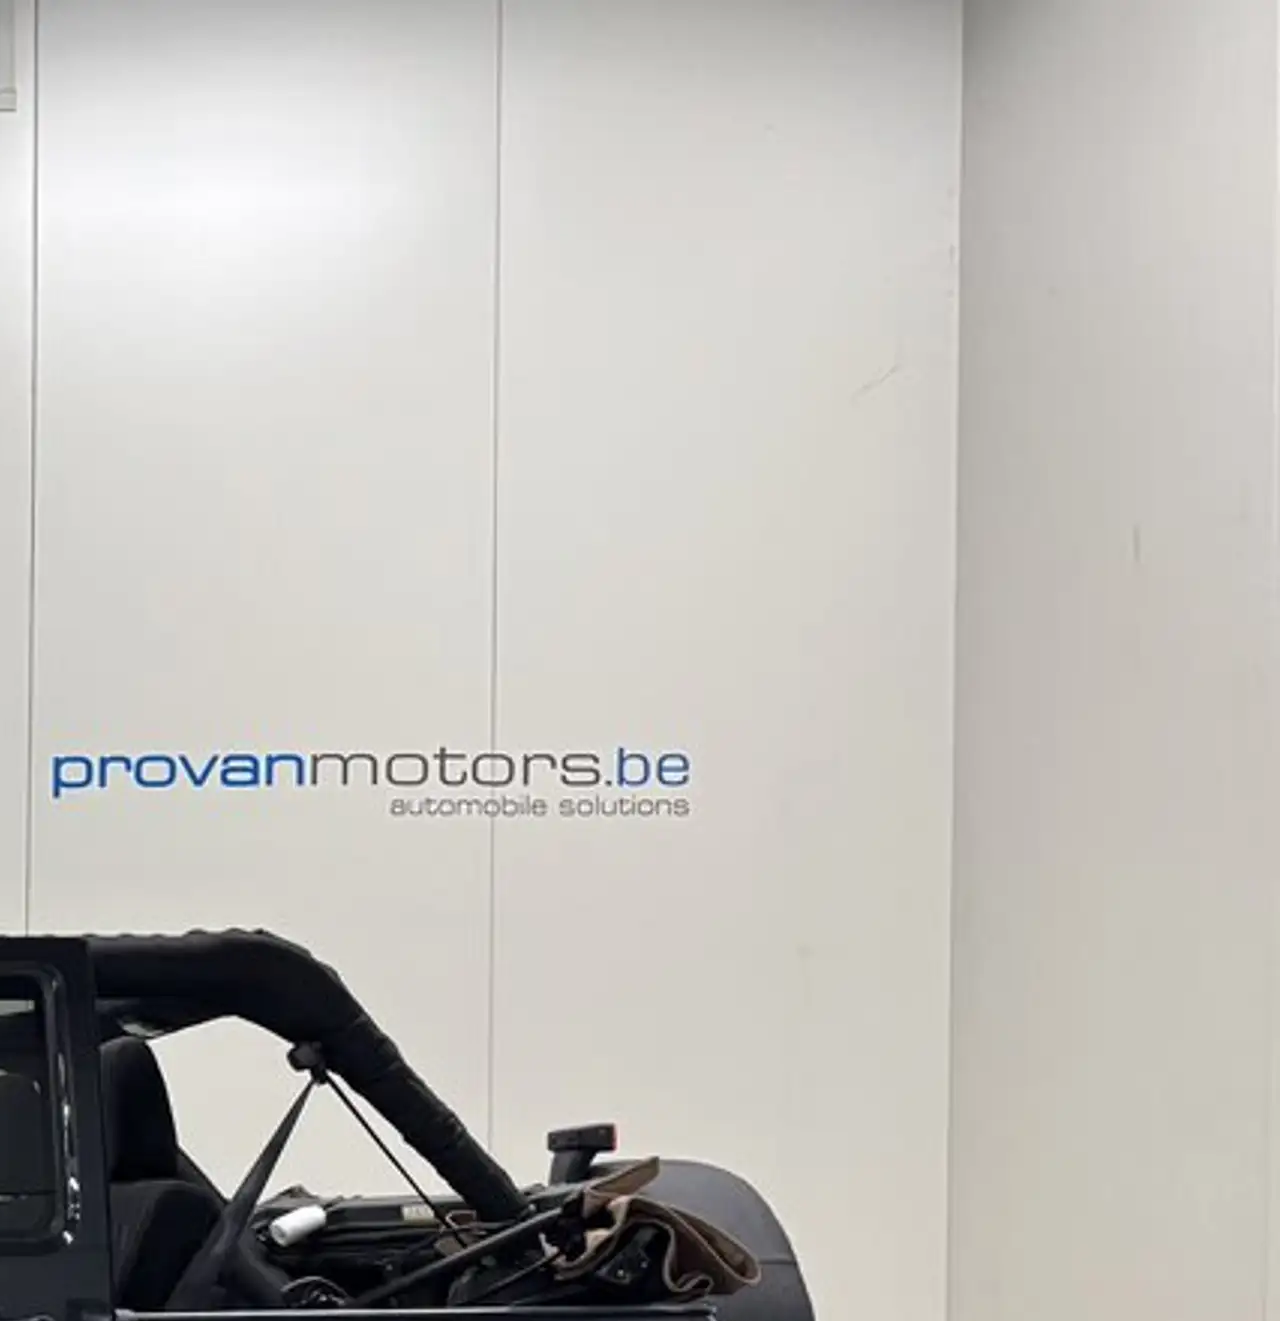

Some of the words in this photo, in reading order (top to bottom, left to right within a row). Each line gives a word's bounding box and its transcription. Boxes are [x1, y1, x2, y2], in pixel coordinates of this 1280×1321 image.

[52, 747, 690, 798] provanmotors.be
[390, 796, 547, 817] automobile
[559, 796, 690, 817] solutions
